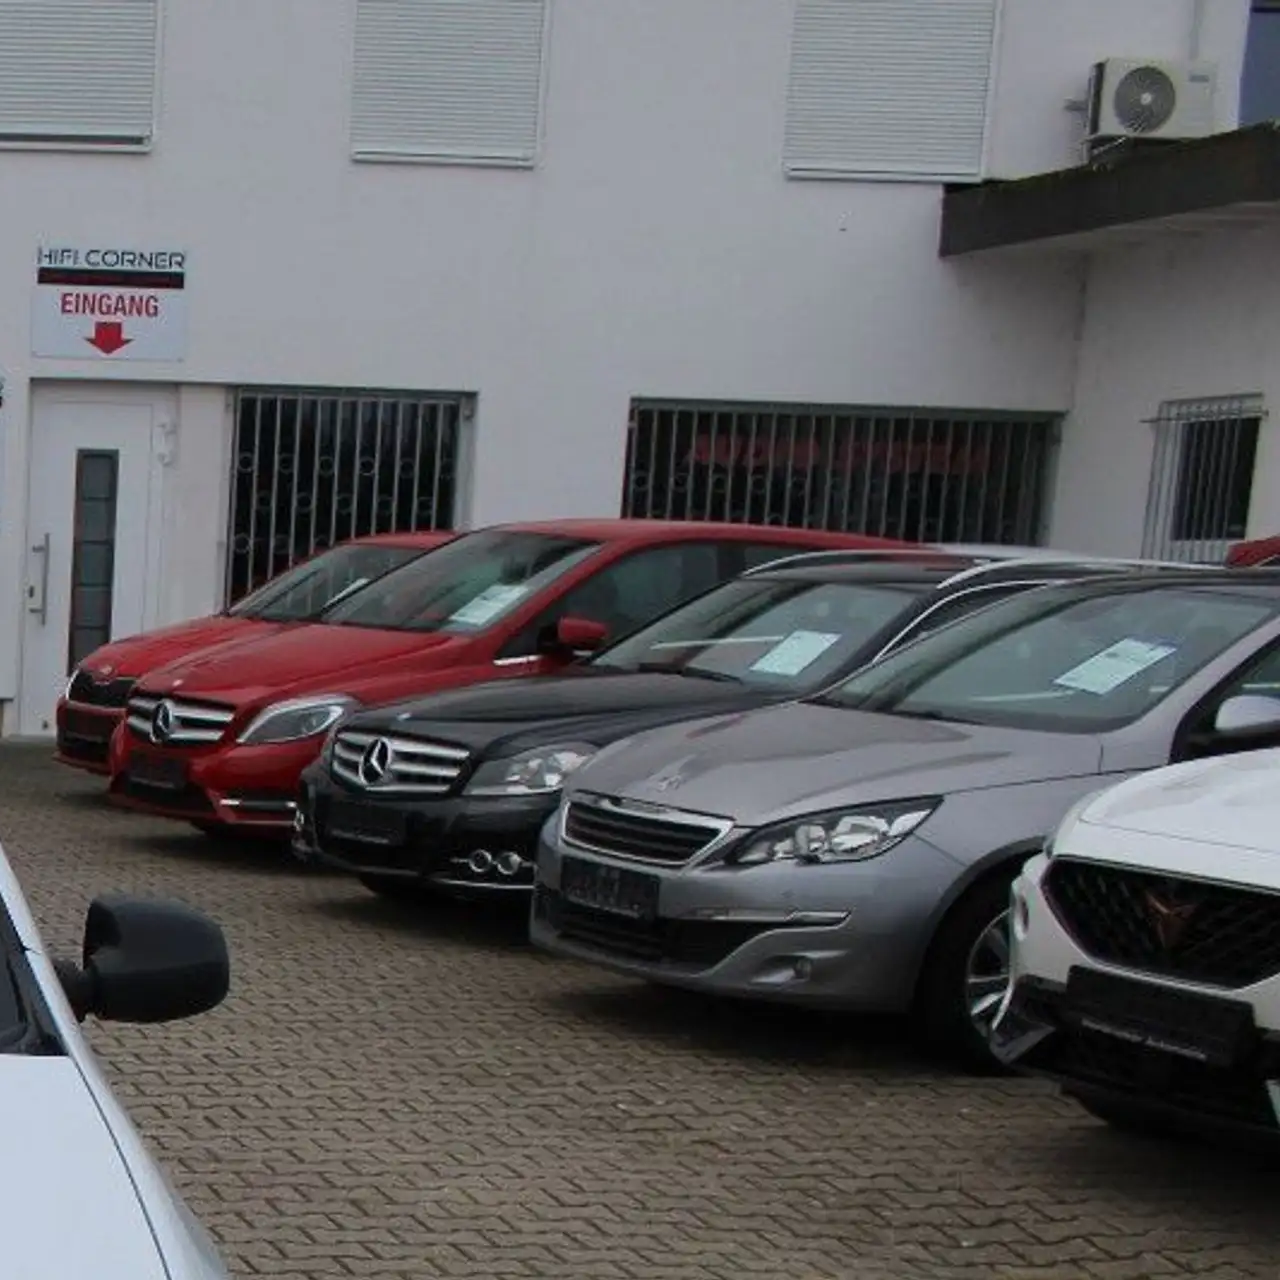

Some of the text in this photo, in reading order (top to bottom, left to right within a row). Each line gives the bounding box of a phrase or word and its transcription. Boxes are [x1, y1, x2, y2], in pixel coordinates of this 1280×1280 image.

[38, 249, 185, 270] HIFI CORNER
[60, 292, 159, 318] EINGANG
